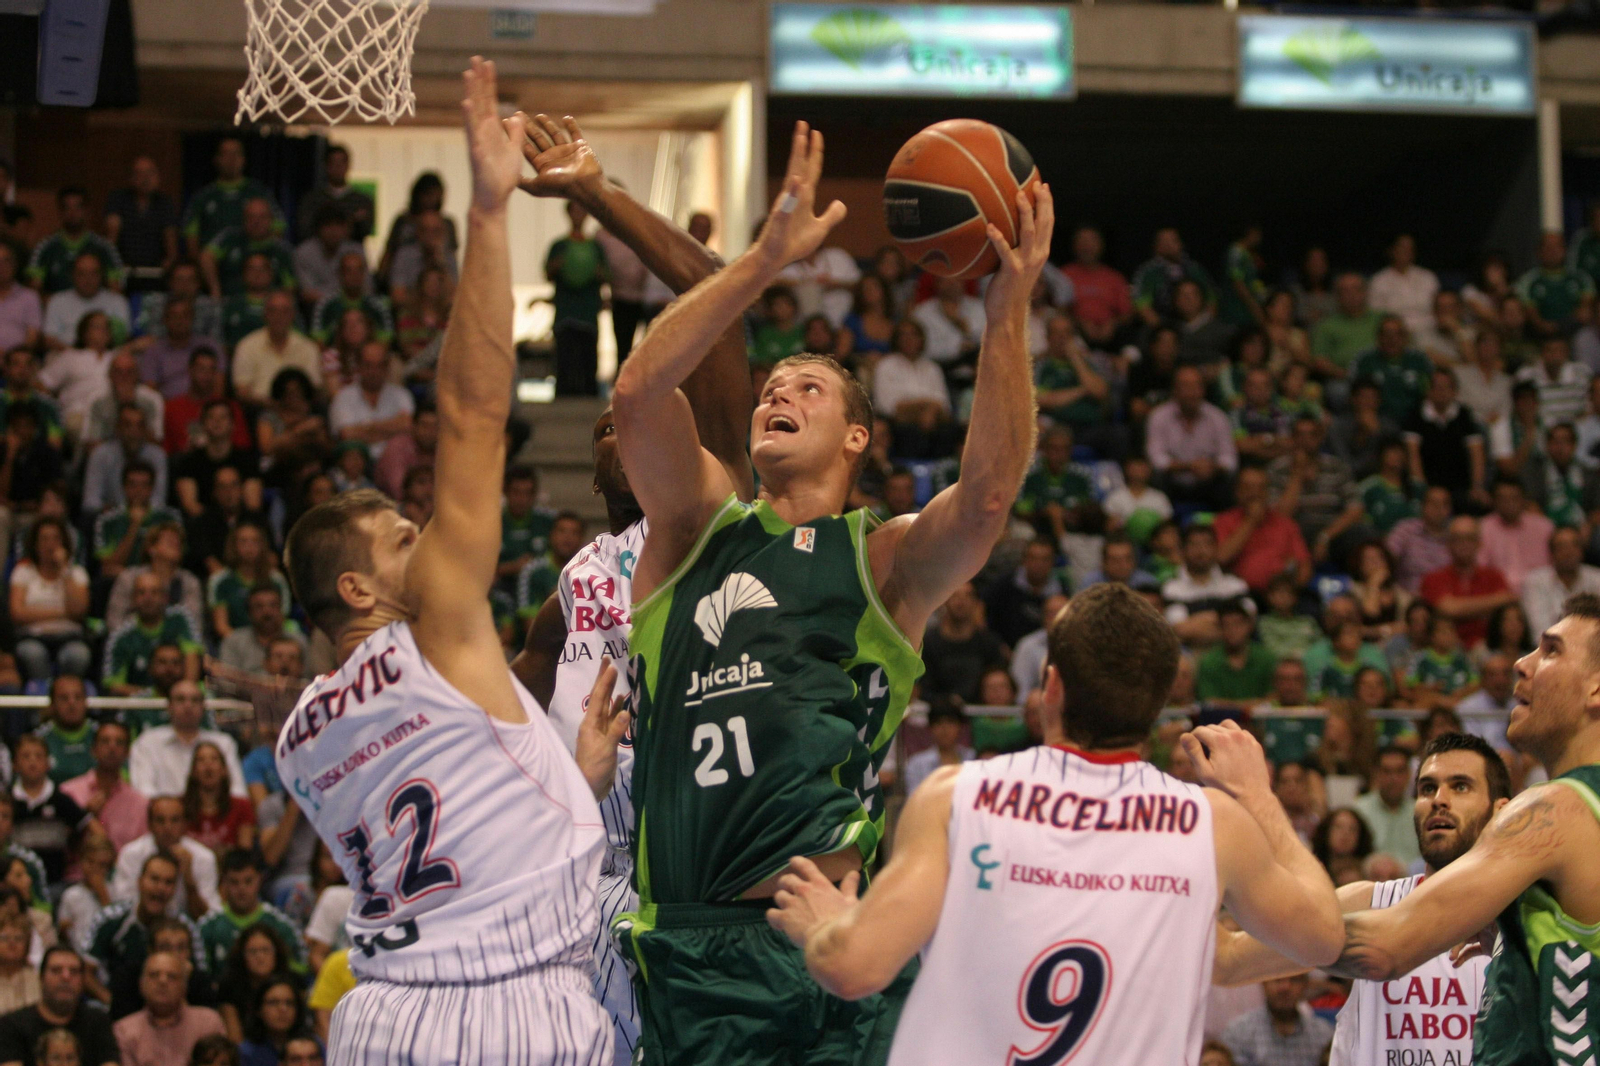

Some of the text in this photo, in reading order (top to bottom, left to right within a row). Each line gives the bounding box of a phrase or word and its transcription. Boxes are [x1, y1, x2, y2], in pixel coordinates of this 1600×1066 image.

[907, 45, 1028, 87] Unicaja
[1374, 62, 1493, 103] Unicaja
[571, 574, 616, 601] AJA
[568, 604, 632, 632] BOR
[312, 713, 431, 792] EUSKADIKO KUTXA
[692, 715, 755, 787] 21
[973, 779, 1199, 835] MARCELINHO
[337, 778, 462, 920] 12
[1009, 864, 1191, 896] EUSKADIKO KUTXA
[1006, 938, 1113, 1066] 9
[1382, 976, 1468, 1008] CAJA
[1385, 1049, 1474, 1066] RIOJA AL
